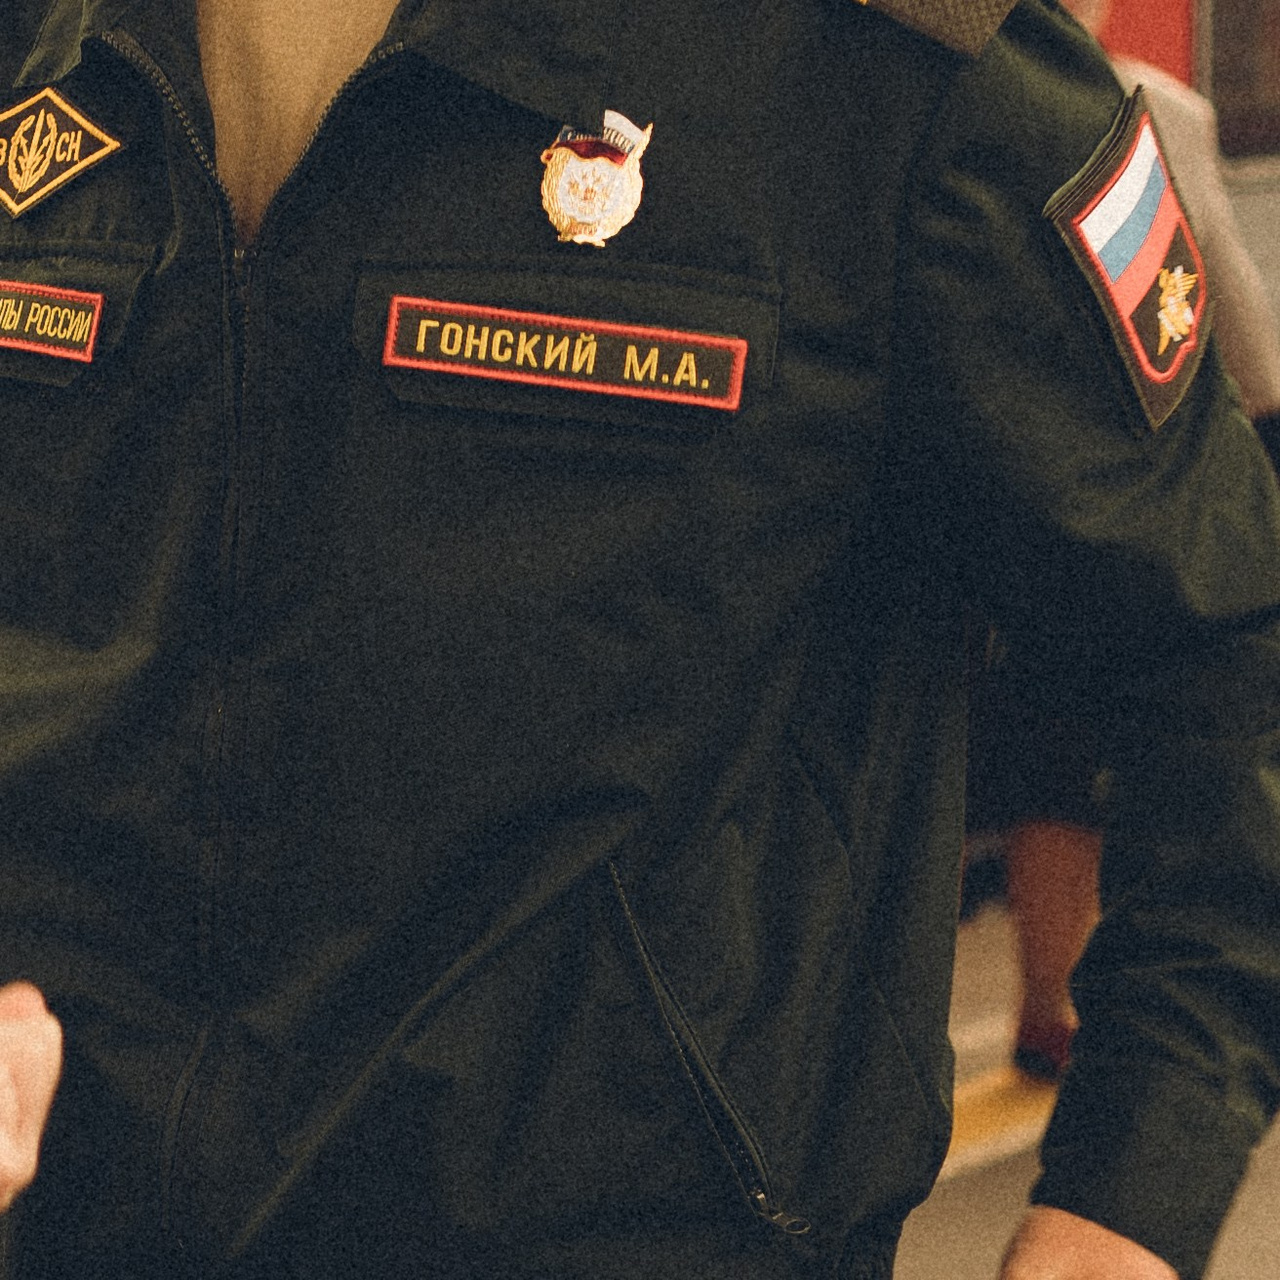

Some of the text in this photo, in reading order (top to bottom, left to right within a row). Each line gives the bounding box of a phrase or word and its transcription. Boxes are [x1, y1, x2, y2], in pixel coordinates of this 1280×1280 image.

[55, 130, 82, 162] СН
[24, 302, 93, 343] РОССИИ
[416, 319, 710, 389] ГОНСКИЙ М.А.
